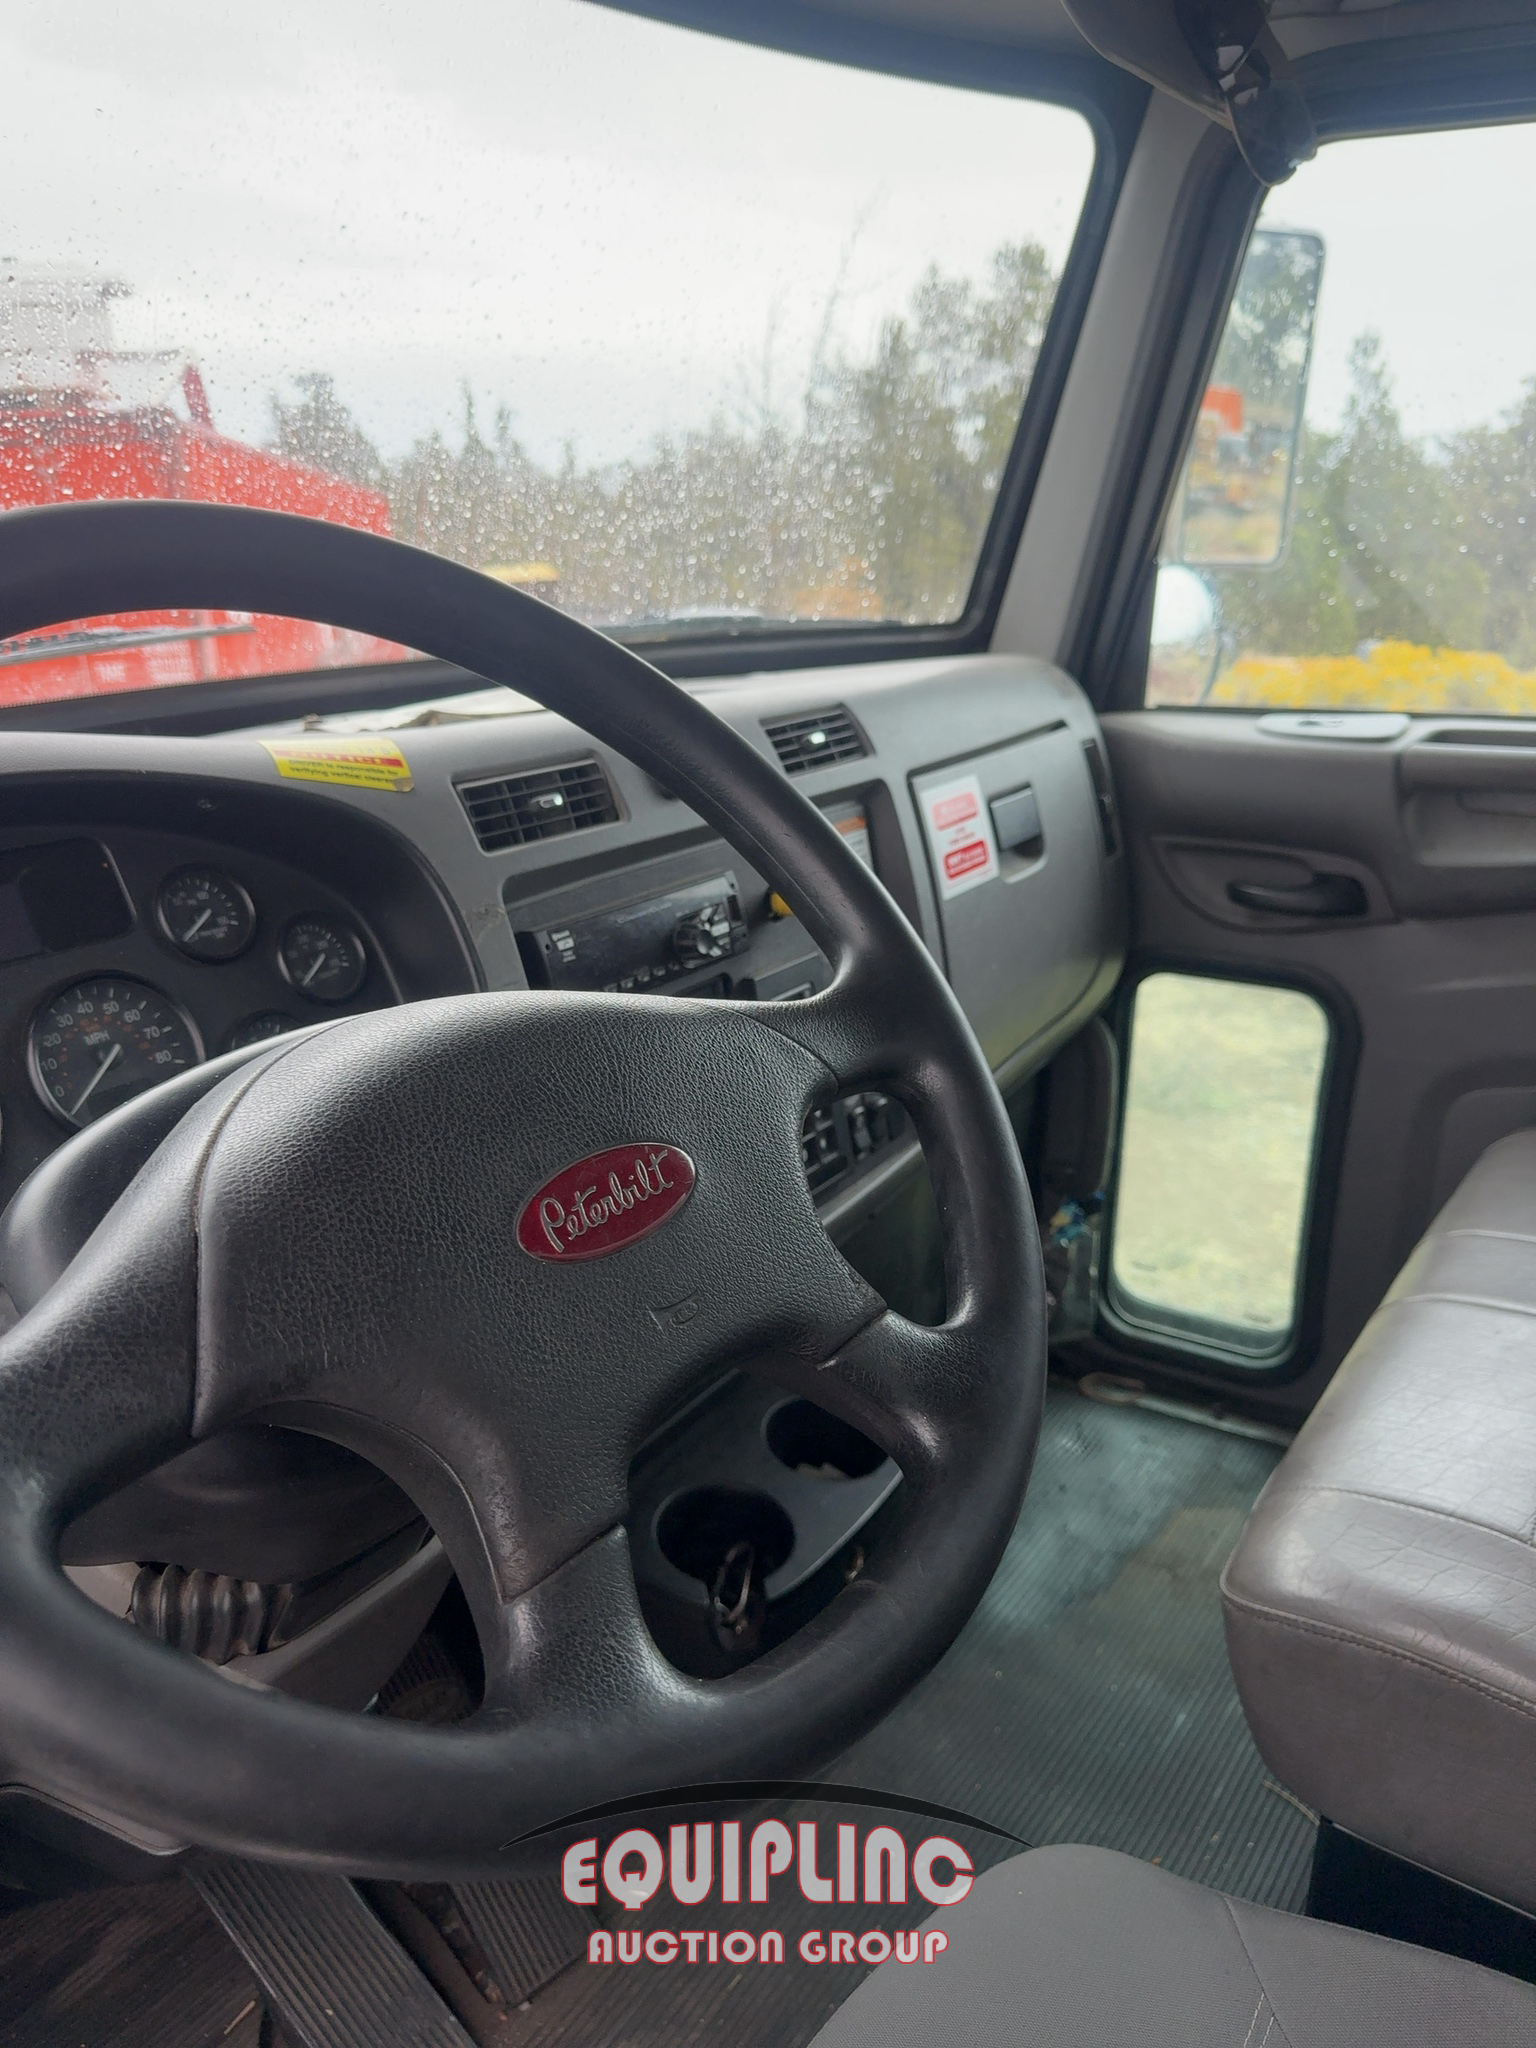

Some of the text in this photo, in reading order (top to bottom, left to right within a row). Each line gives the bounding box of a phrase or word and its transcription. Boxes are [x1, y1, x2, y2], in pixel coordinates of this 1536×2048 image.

[76, 1001, 94, 1014] 40
[103, 1001, 120, 1014] 50
[56, 1013, 73, 1028] 30
[124, 1009, 141, 1023] 60
[83, 1030, 110, 1046] MPH
[143, 1026, 160, 1039] 70
[43, 1033, 61, 1047] 20
[155, 1050, 172, 1064] 80
[41, 1058, 57, 1071] 10
[55, 1085, 65, 1097] 0
[540, 1149, 674, 1253] Peterbilt
